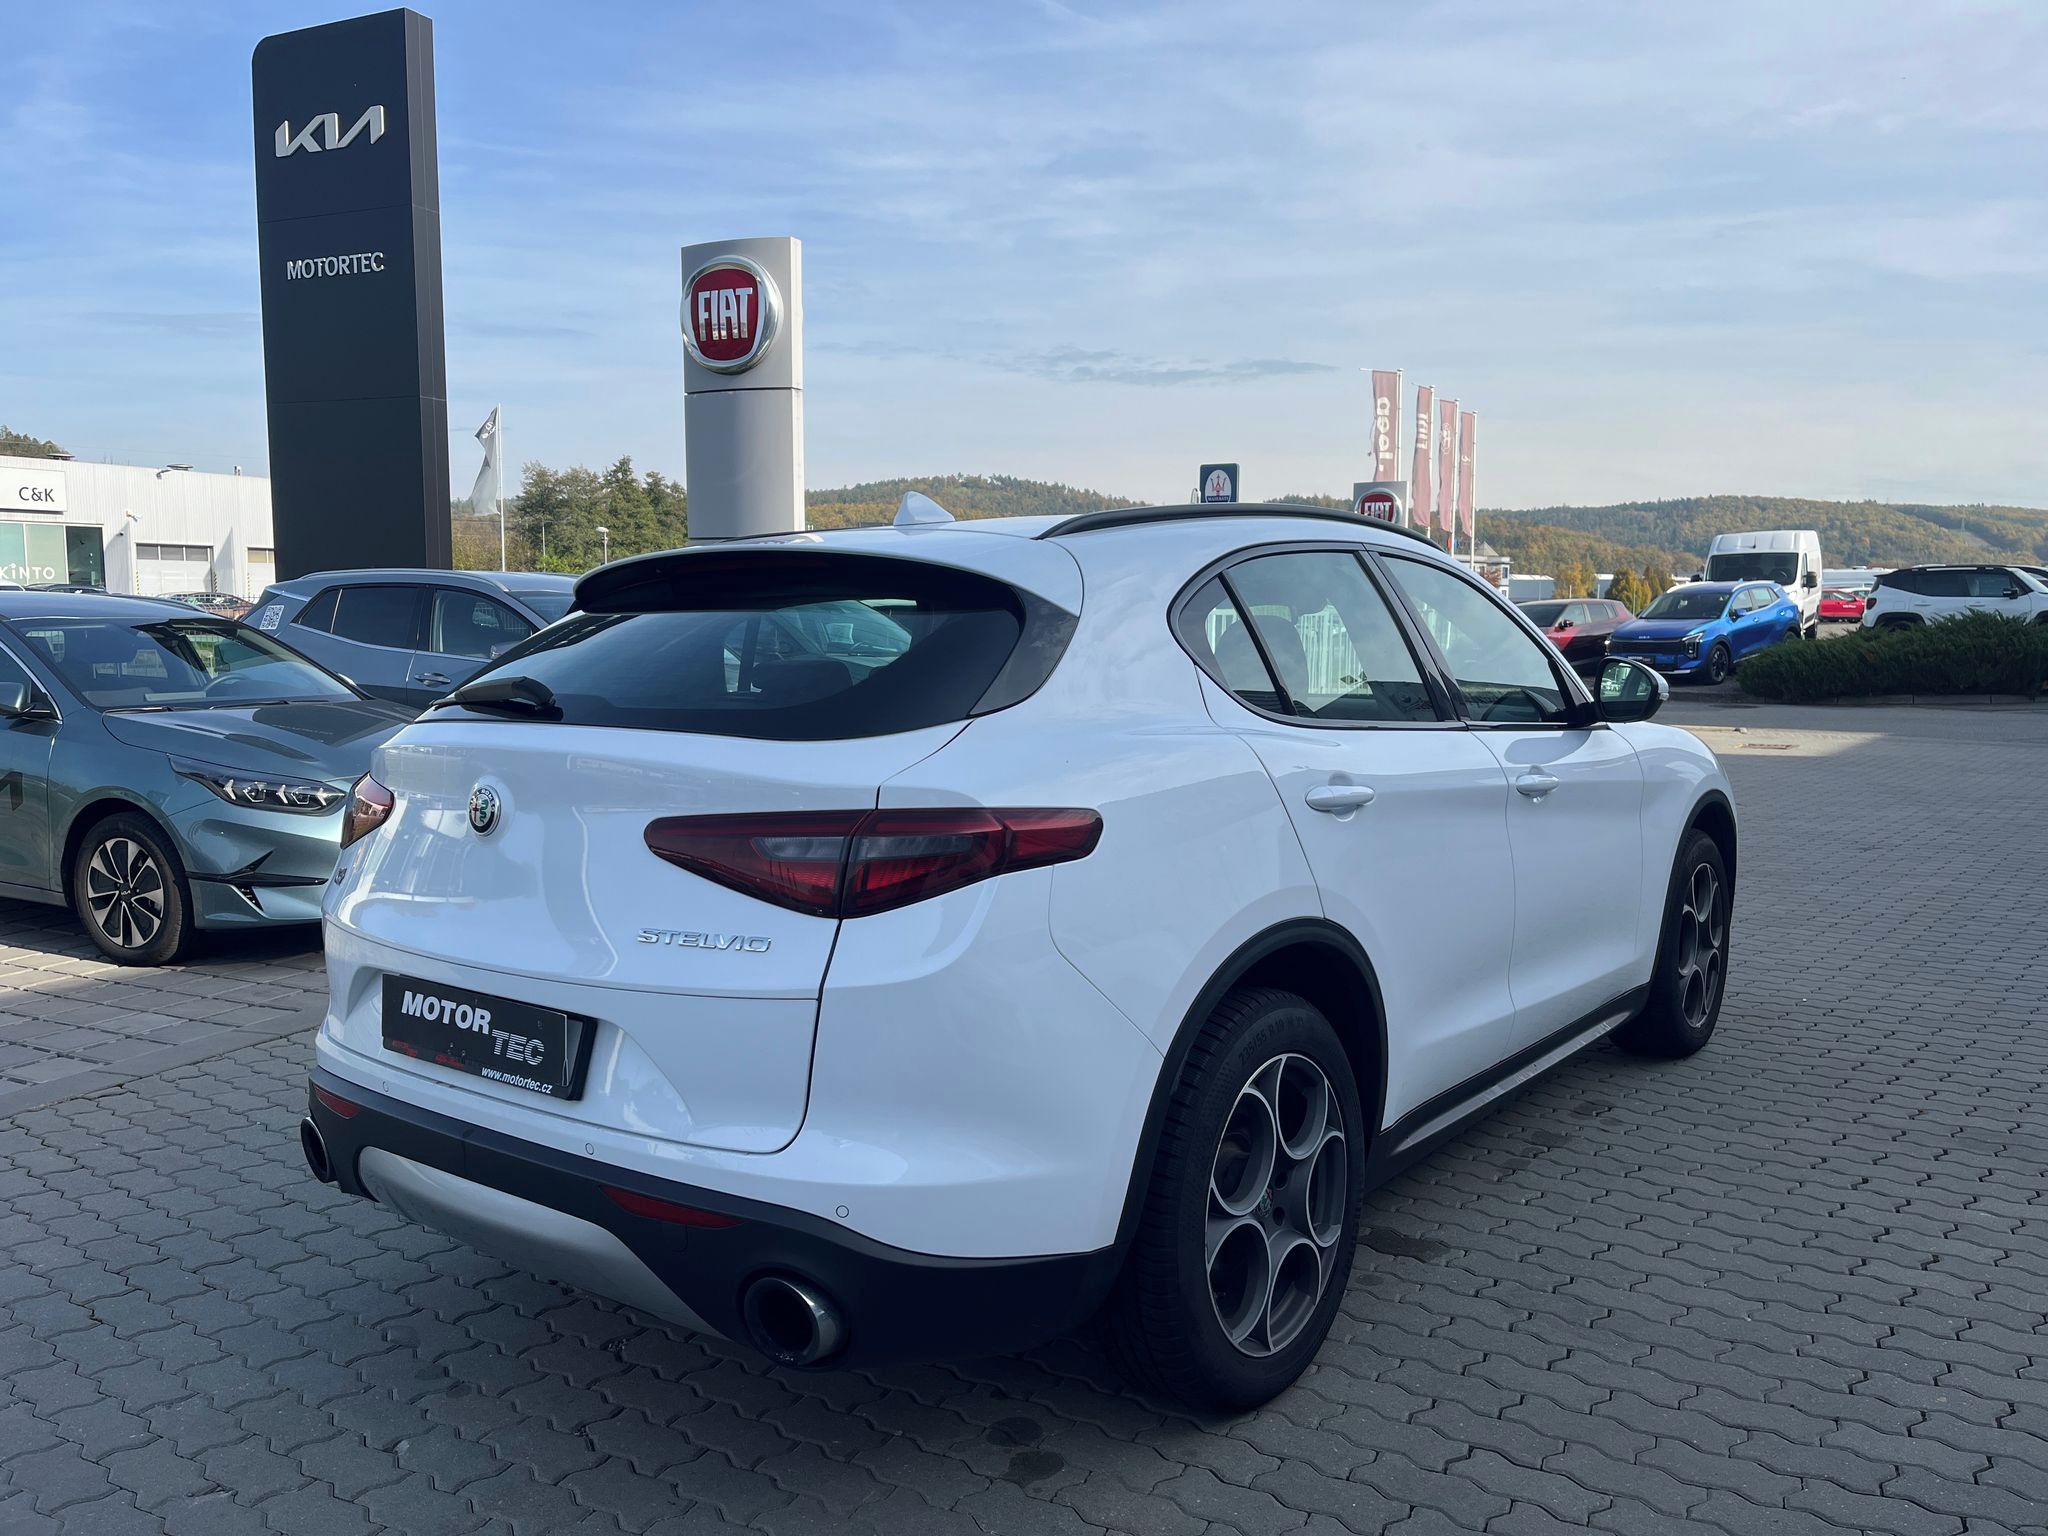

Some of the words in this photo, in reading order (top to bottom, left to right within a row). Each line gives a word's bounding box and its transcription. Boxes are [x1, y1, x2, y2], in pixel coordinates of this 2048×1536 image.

[275, 105, 384, 158] KIA
[287, 252, 384, 280] MOTORTEC
[698, 287, 753, 341] FIAT
[19, 487, 54, 502] C&K
[637, 928, 771, 952] STELVIO
[401, 990, 492, 1035] MOTOR
[492, 1029, 545, 1066] TEC
[481, 1066, 553, 1094] www.motortec.cz
